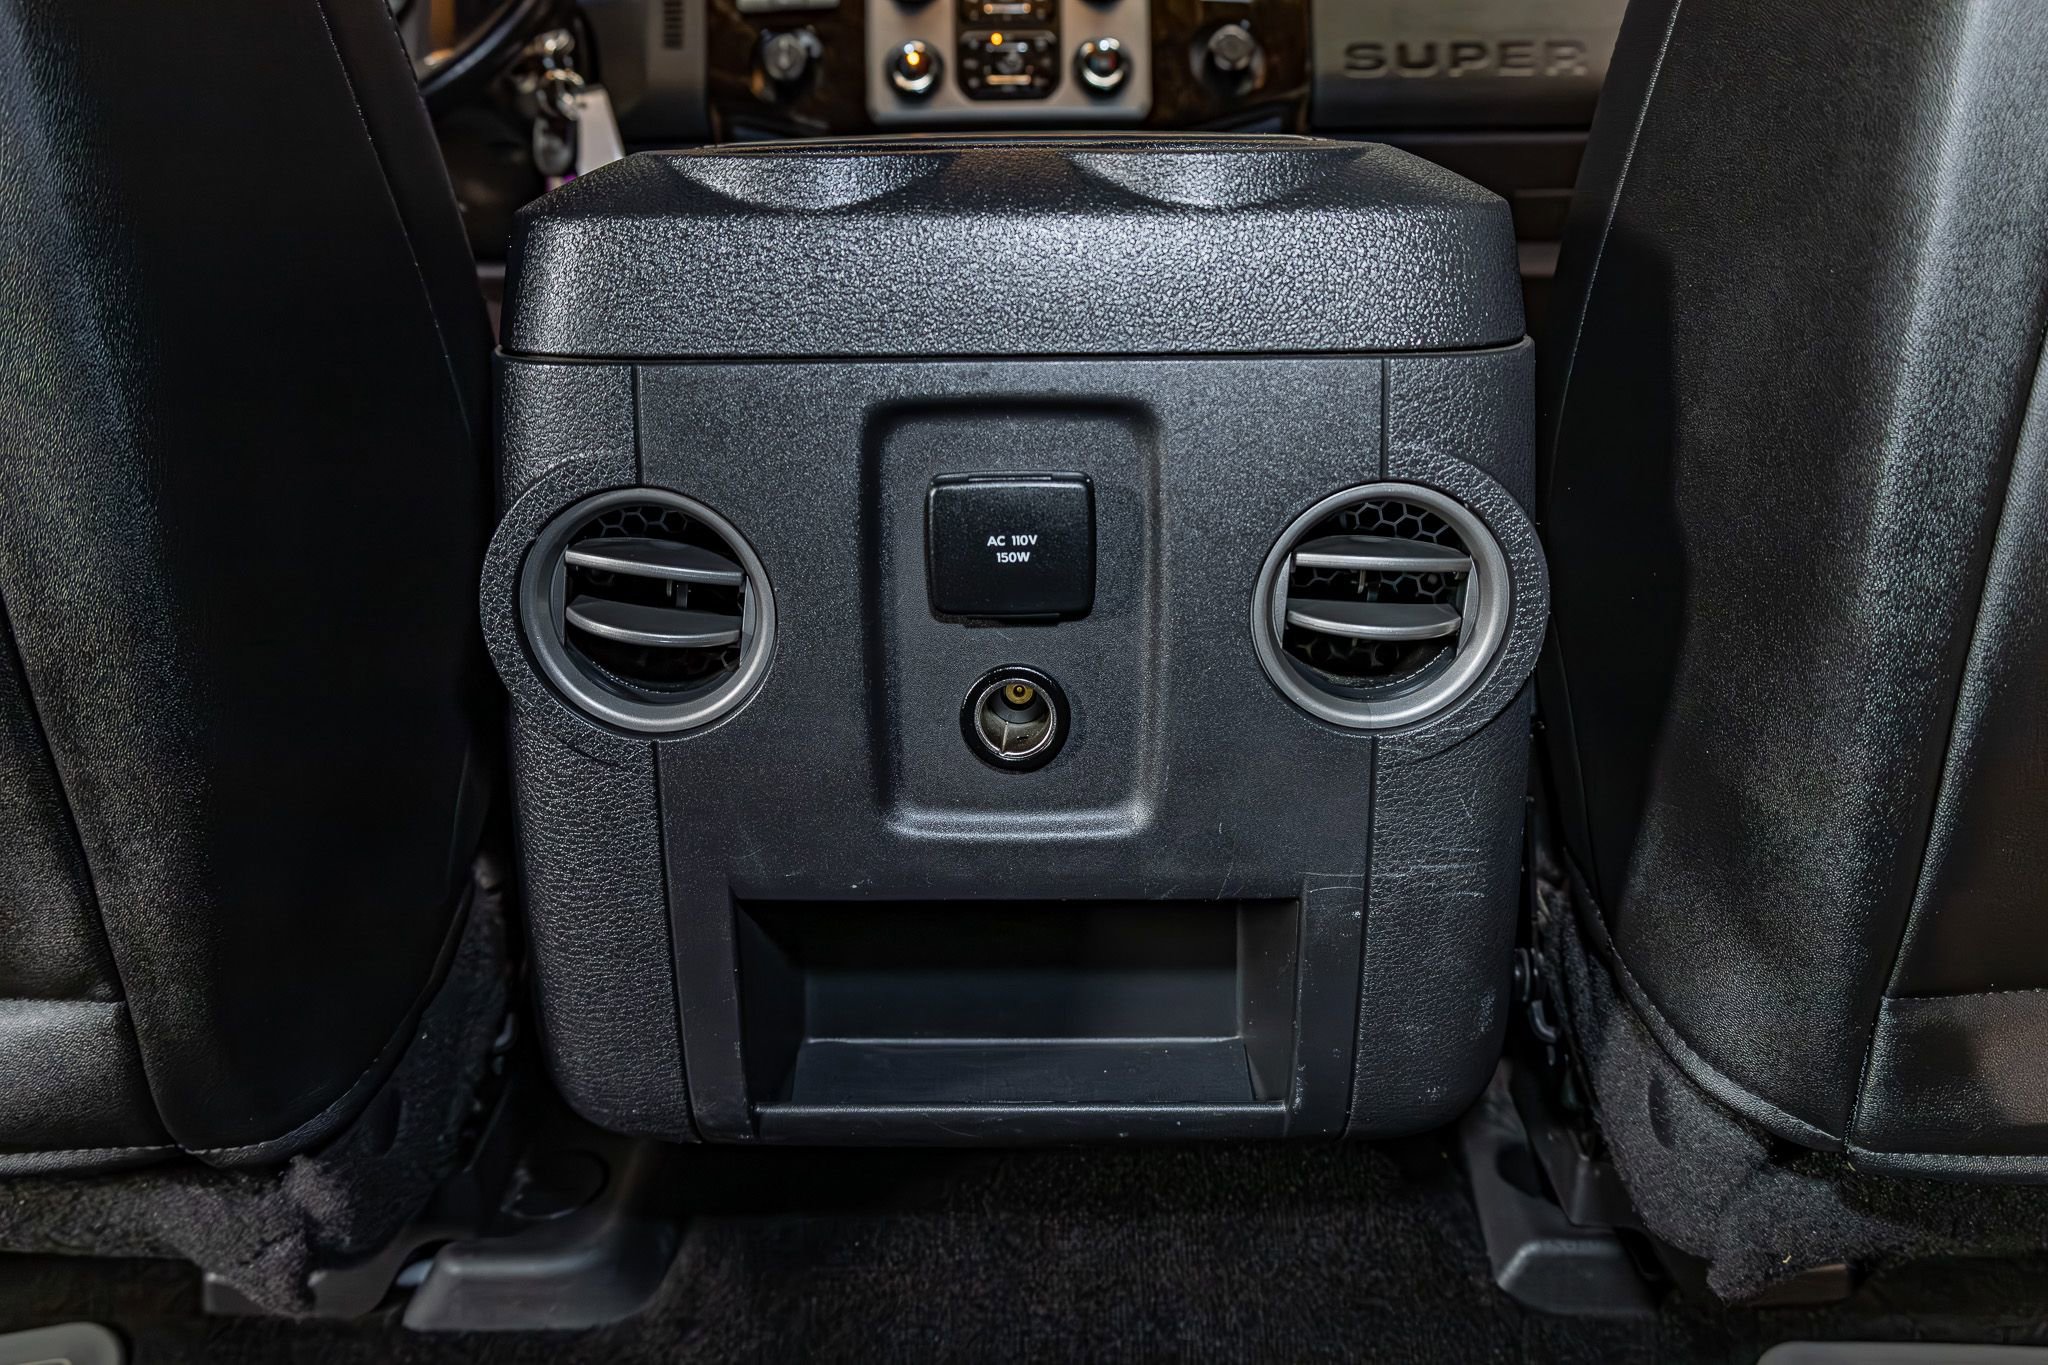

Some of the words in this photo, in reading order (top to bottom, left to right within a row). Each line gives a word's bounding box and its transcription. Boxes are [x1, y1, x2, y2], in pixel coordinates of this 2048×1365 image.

[1344, 41, 1588, 78] SUPER
[987, 535, 1006, 546] AC
[1011, 534, 1038, 546] 110V
[996, 551, 1031, 563] 150W
